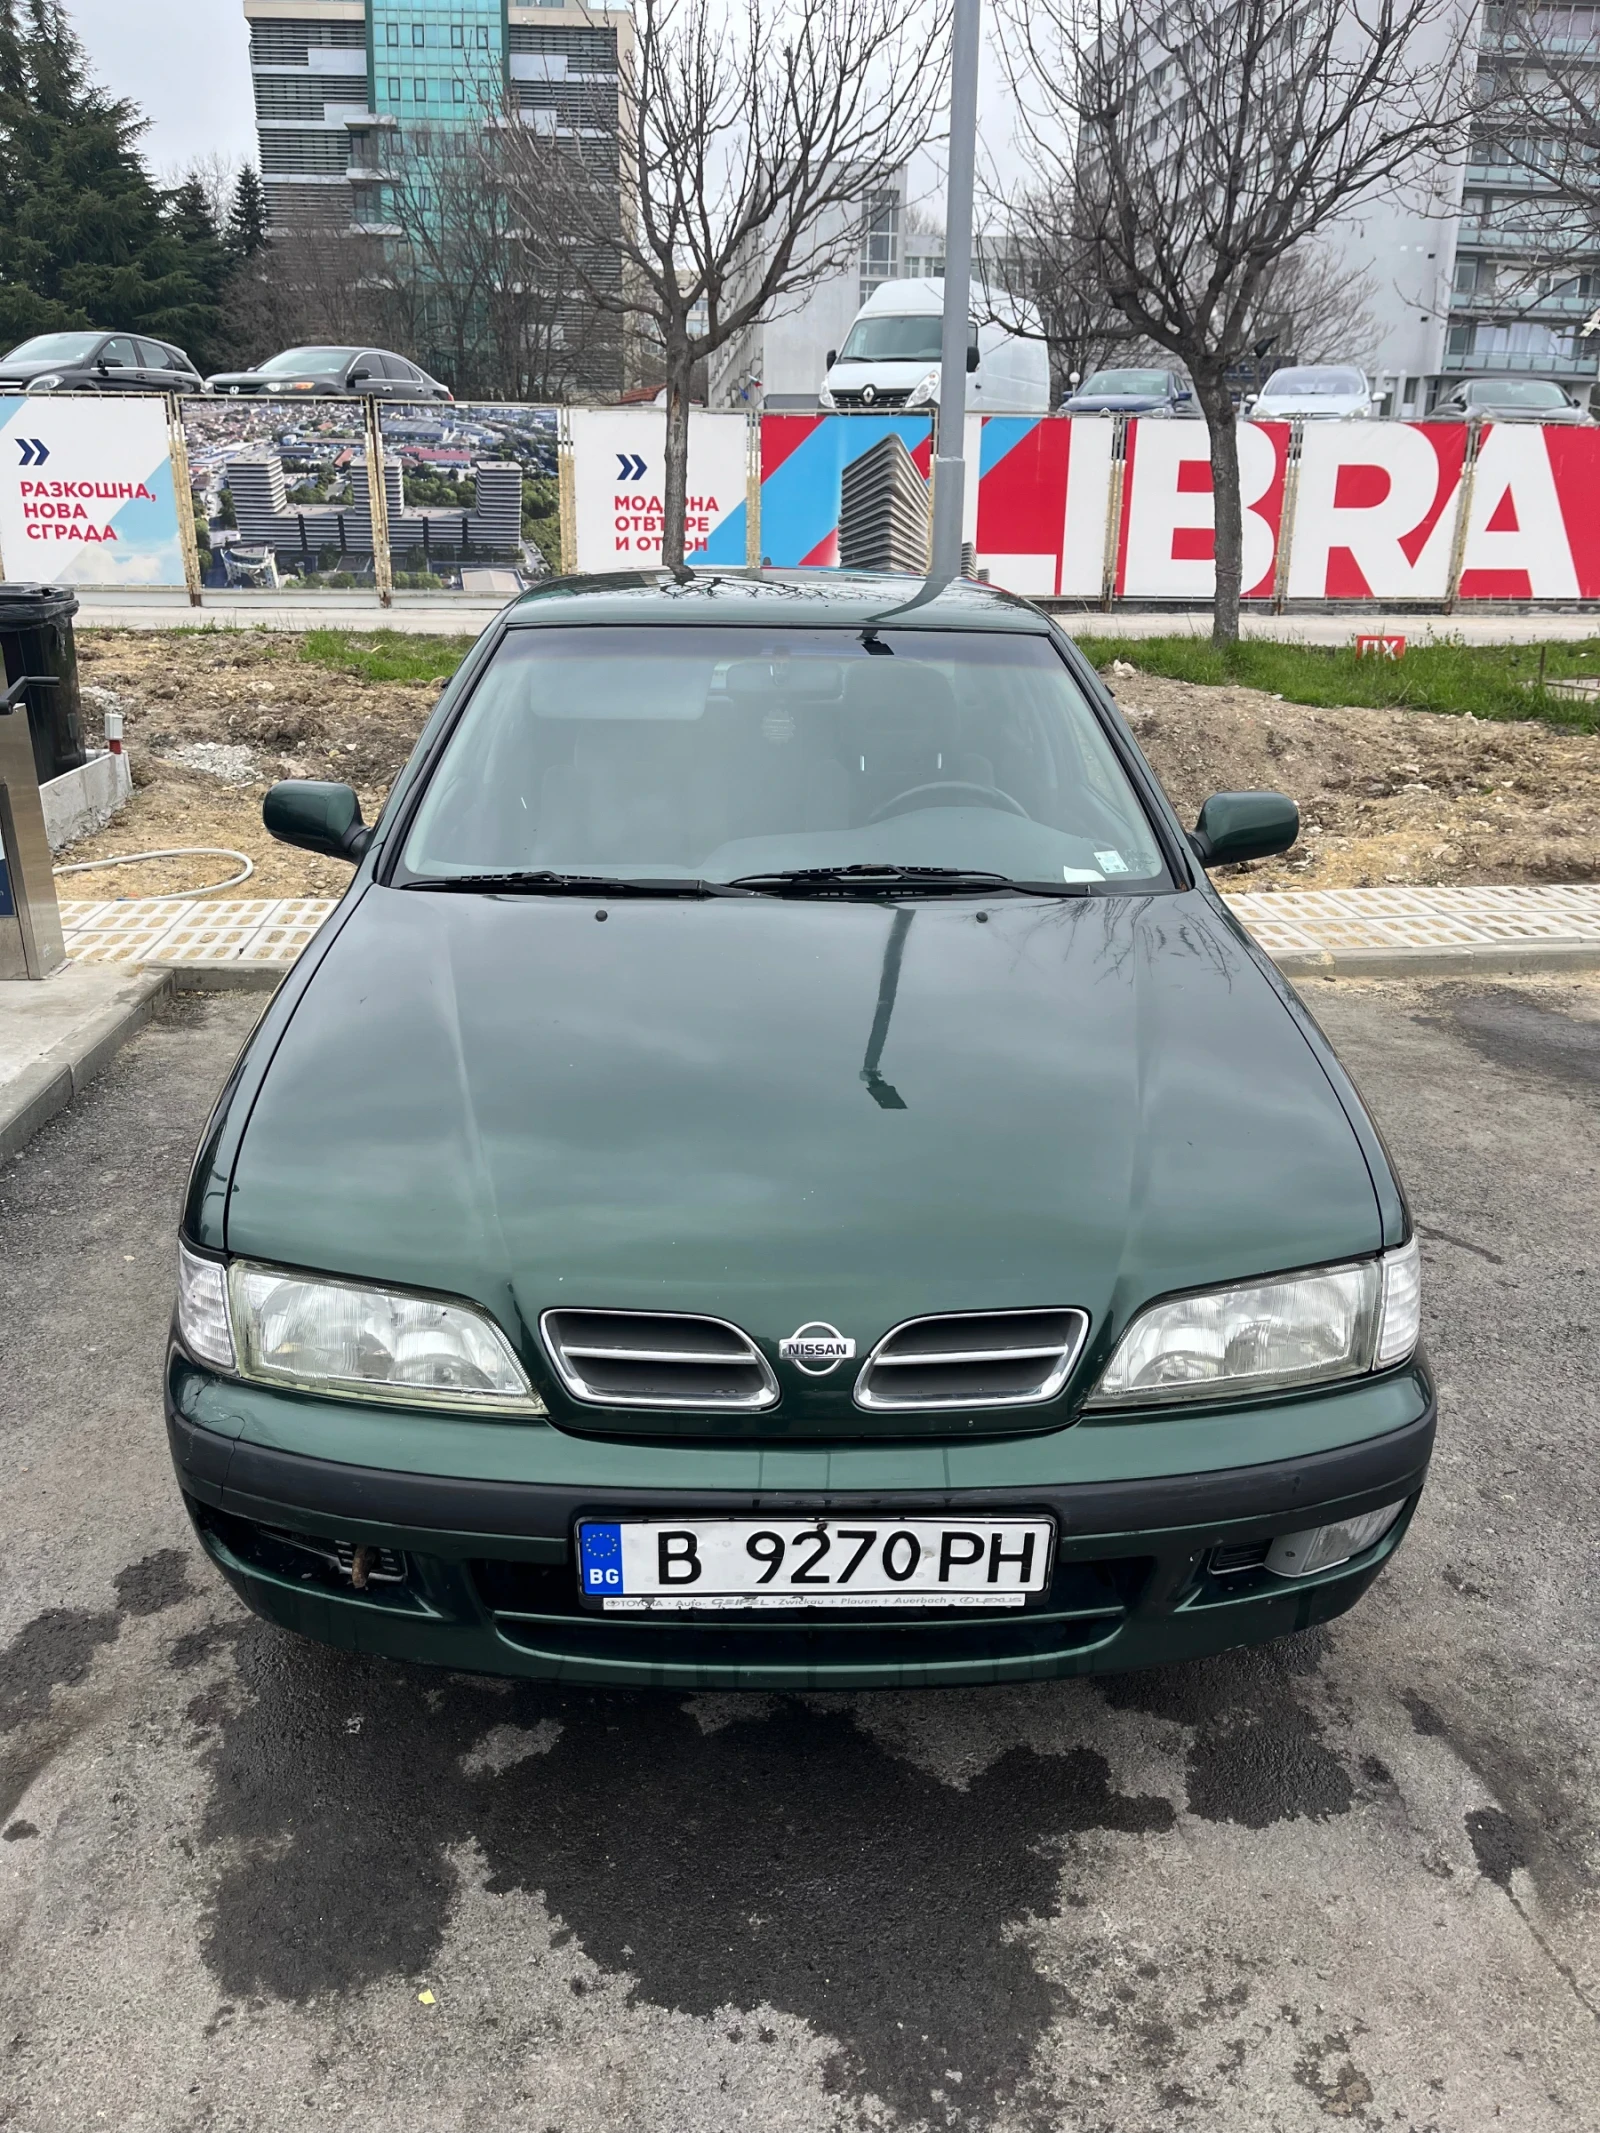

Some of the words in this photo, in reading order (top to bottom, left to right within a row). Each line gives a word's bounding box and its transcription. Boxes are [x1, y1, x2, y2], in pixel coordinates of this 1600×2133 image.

[20, 481, 156, 502] РАЗКОШНА,
[23, 502, 88, 519] НОВА
[614, 495, 719, 514] МОДНА
[962, 416, 1582, 600] LIBRA
[26, 523, 118, 542] СГРАДА
[614, 516, 709, 532] ОТВРЕ
[615, 536, 630, 551] И
[636, 536, 708, 552] ОТЪН
[788, 1343, 847, 1355] NISSAN
[658, 1531, 702, 1585] B
[745, 1530, 921, 1585] 9270
[938, 1531, 1036, 1584] PH
[590, 1569, 620, 1585] BG
[840, 1597, 878, 1605] Plauen
[893, 1596, 947, 1605] Auerbach
[975, 1597, 1023, 1605] LEXUS
